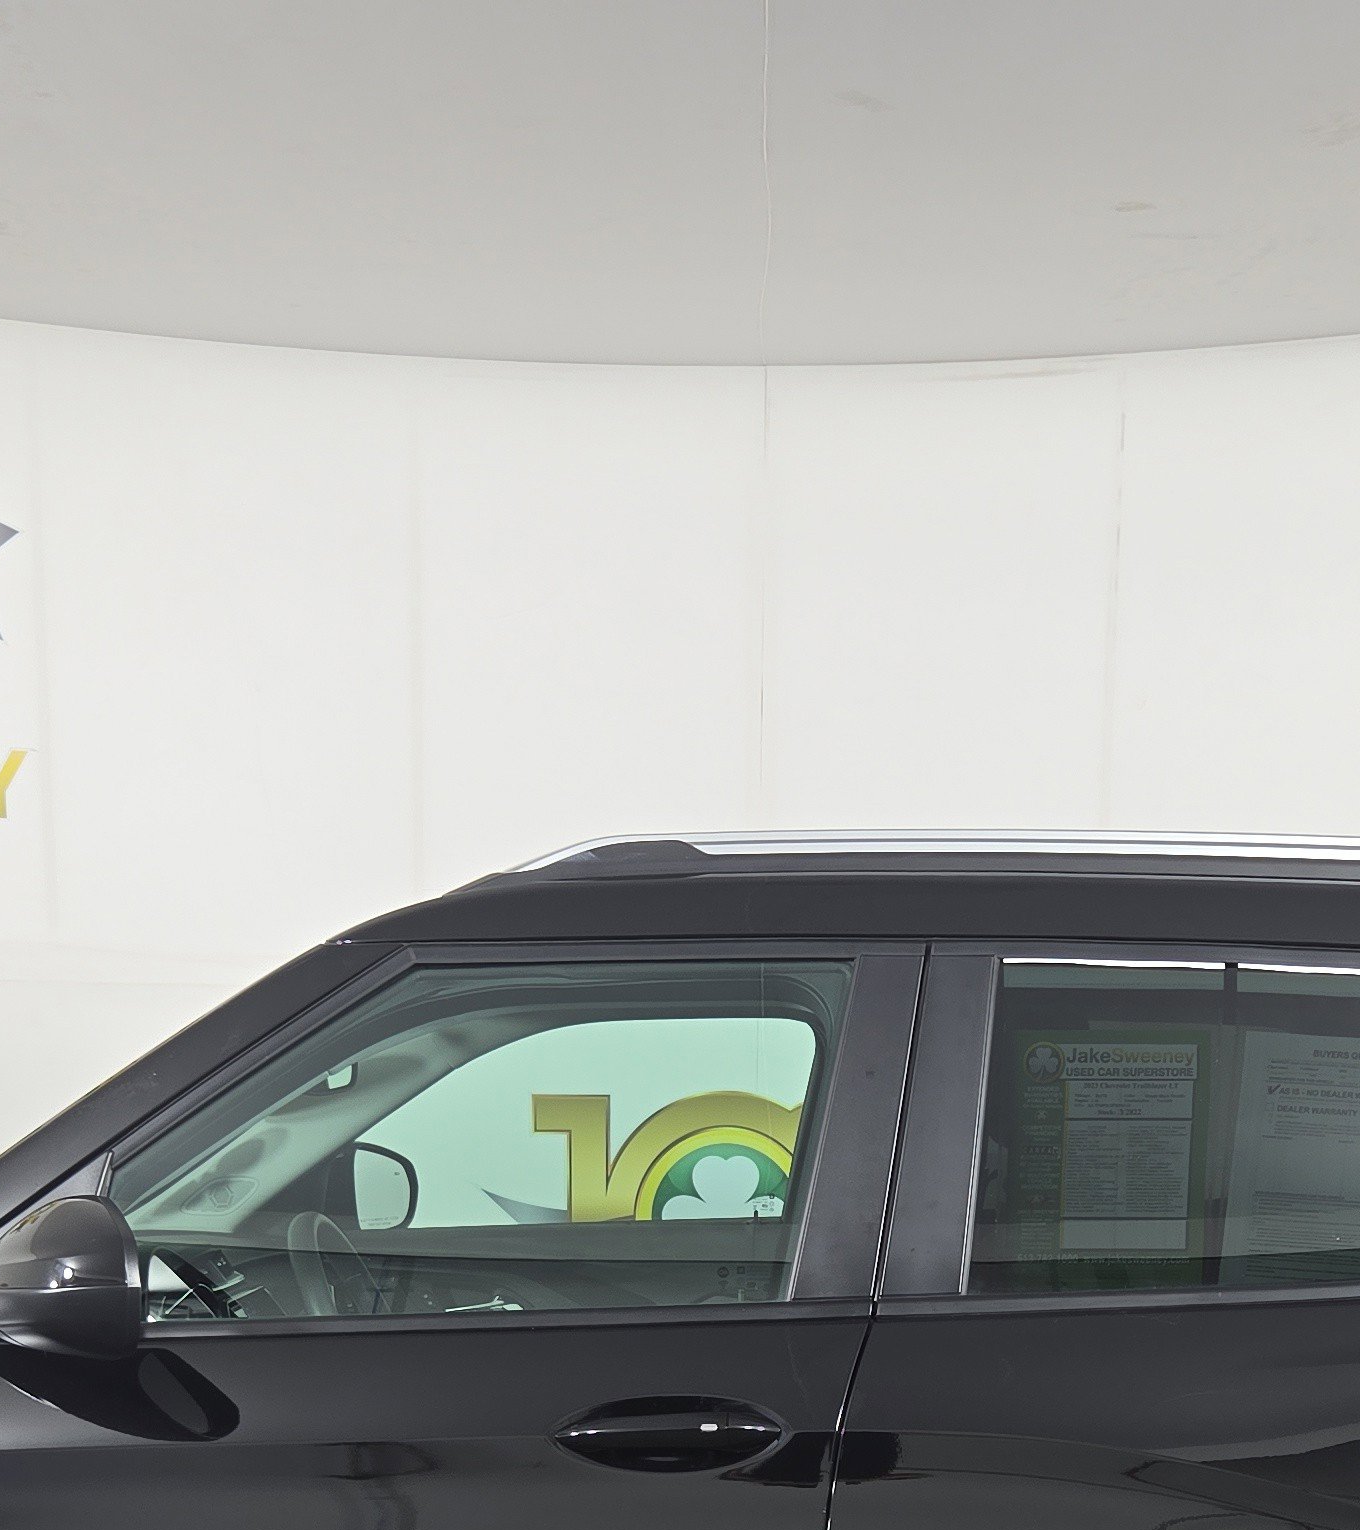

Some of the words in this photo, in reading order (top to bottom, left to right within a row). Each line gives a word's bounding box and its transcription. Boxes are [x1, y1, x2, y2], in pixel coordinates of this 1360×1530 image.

[1312, 1049, 1349, 1060] BUYERS
[1066, 1067, 1094, 1077] USED
[1097, 1067, 1120, 1077] CAR
[1122, 1067, 1194, 1077] SUPERSTORE
[1306, 1089, 1319, 1097] NO
[1320, 1090, 1353, 1099] DEALER
[1277, 1105, 1310, 1114] DEALER
[1311, 1107, 1358, 1117] WARRANTY
